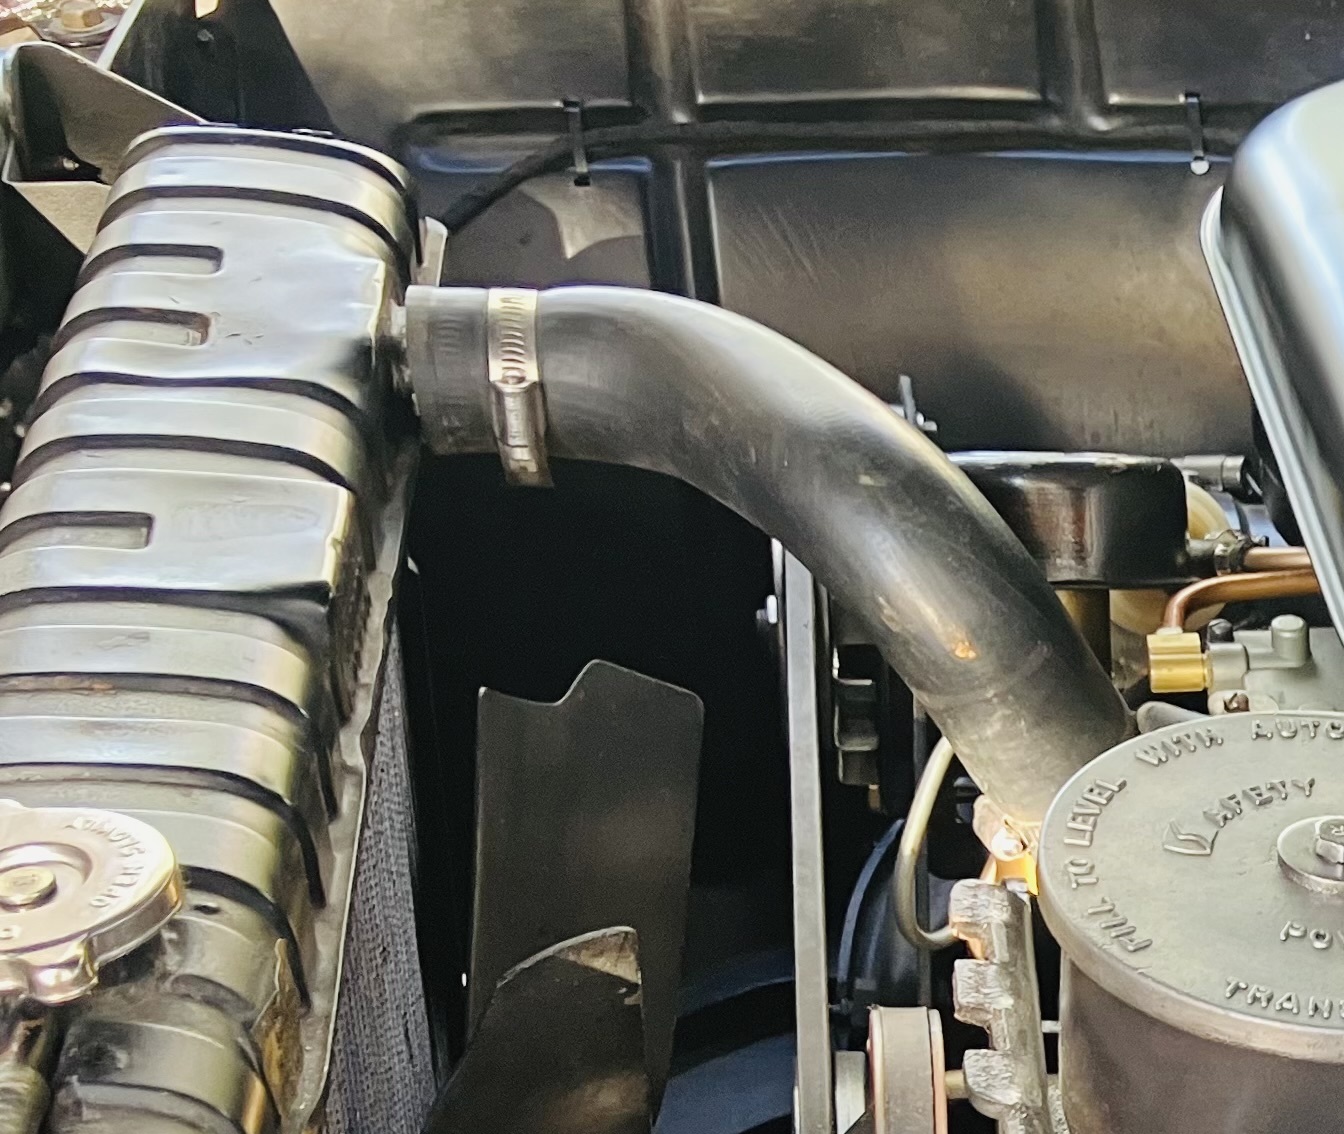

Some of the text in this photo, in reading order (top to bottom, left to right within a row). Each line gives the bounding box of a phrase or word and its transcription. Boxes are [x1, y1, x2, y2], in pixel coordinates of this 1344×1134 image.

[1133, 727, 1225, 768] WITH
[1063, 777, 1127, 846] LEVEL
[1065, 858, 1099, 889] TO
[1087, 897, 1152, 952] FILL
